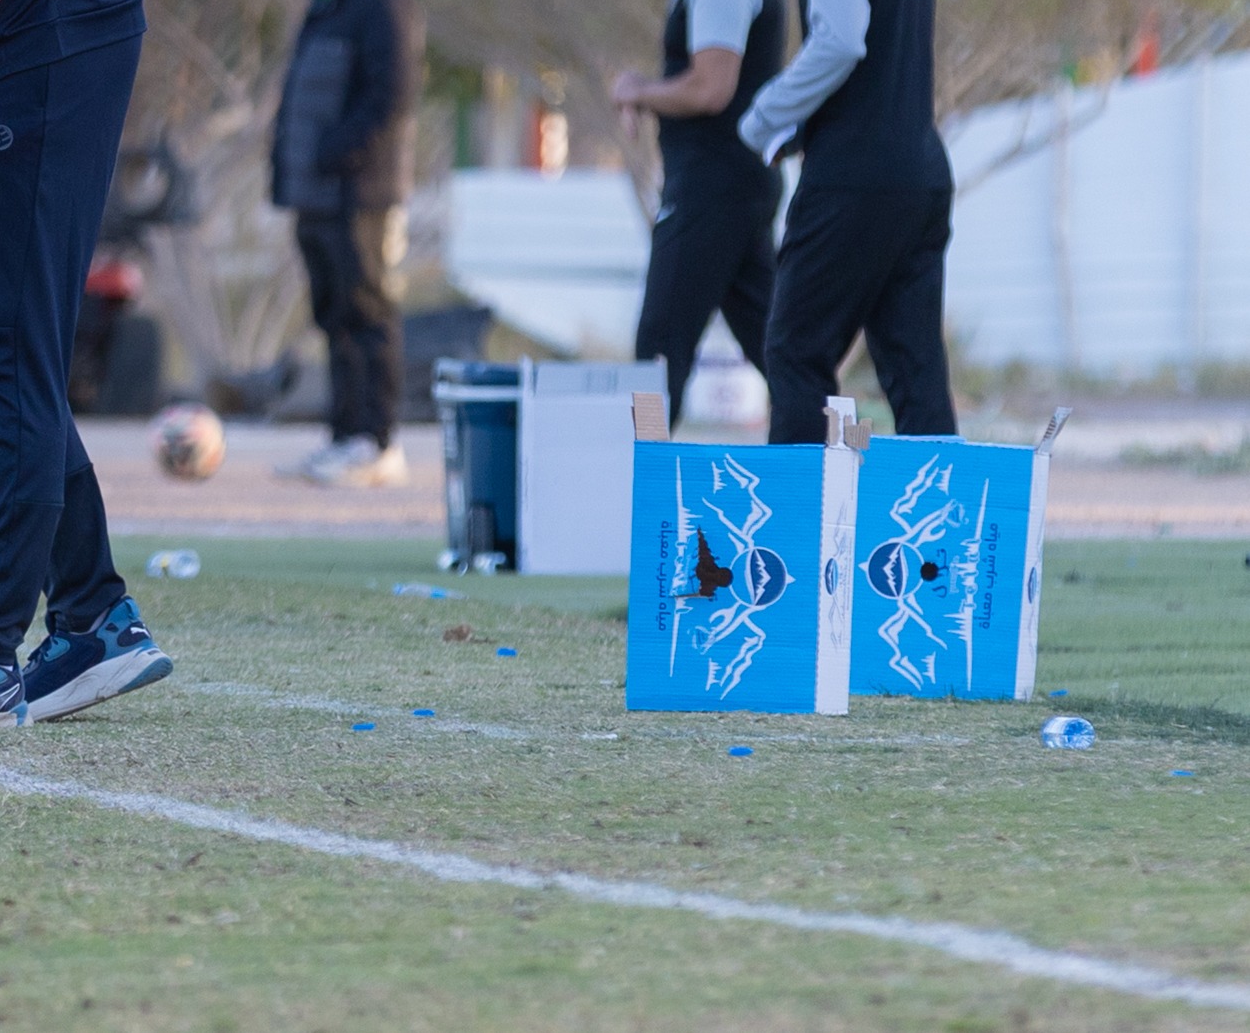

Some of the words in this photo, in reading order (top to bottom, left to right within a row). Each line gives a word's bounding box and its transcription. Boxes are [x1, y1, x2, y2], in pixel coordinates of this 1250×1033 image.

[984, 523, 1001, 551] مياه
[982, 555, 998, 589] شرب
[655, 602, 671, 631] مياه
